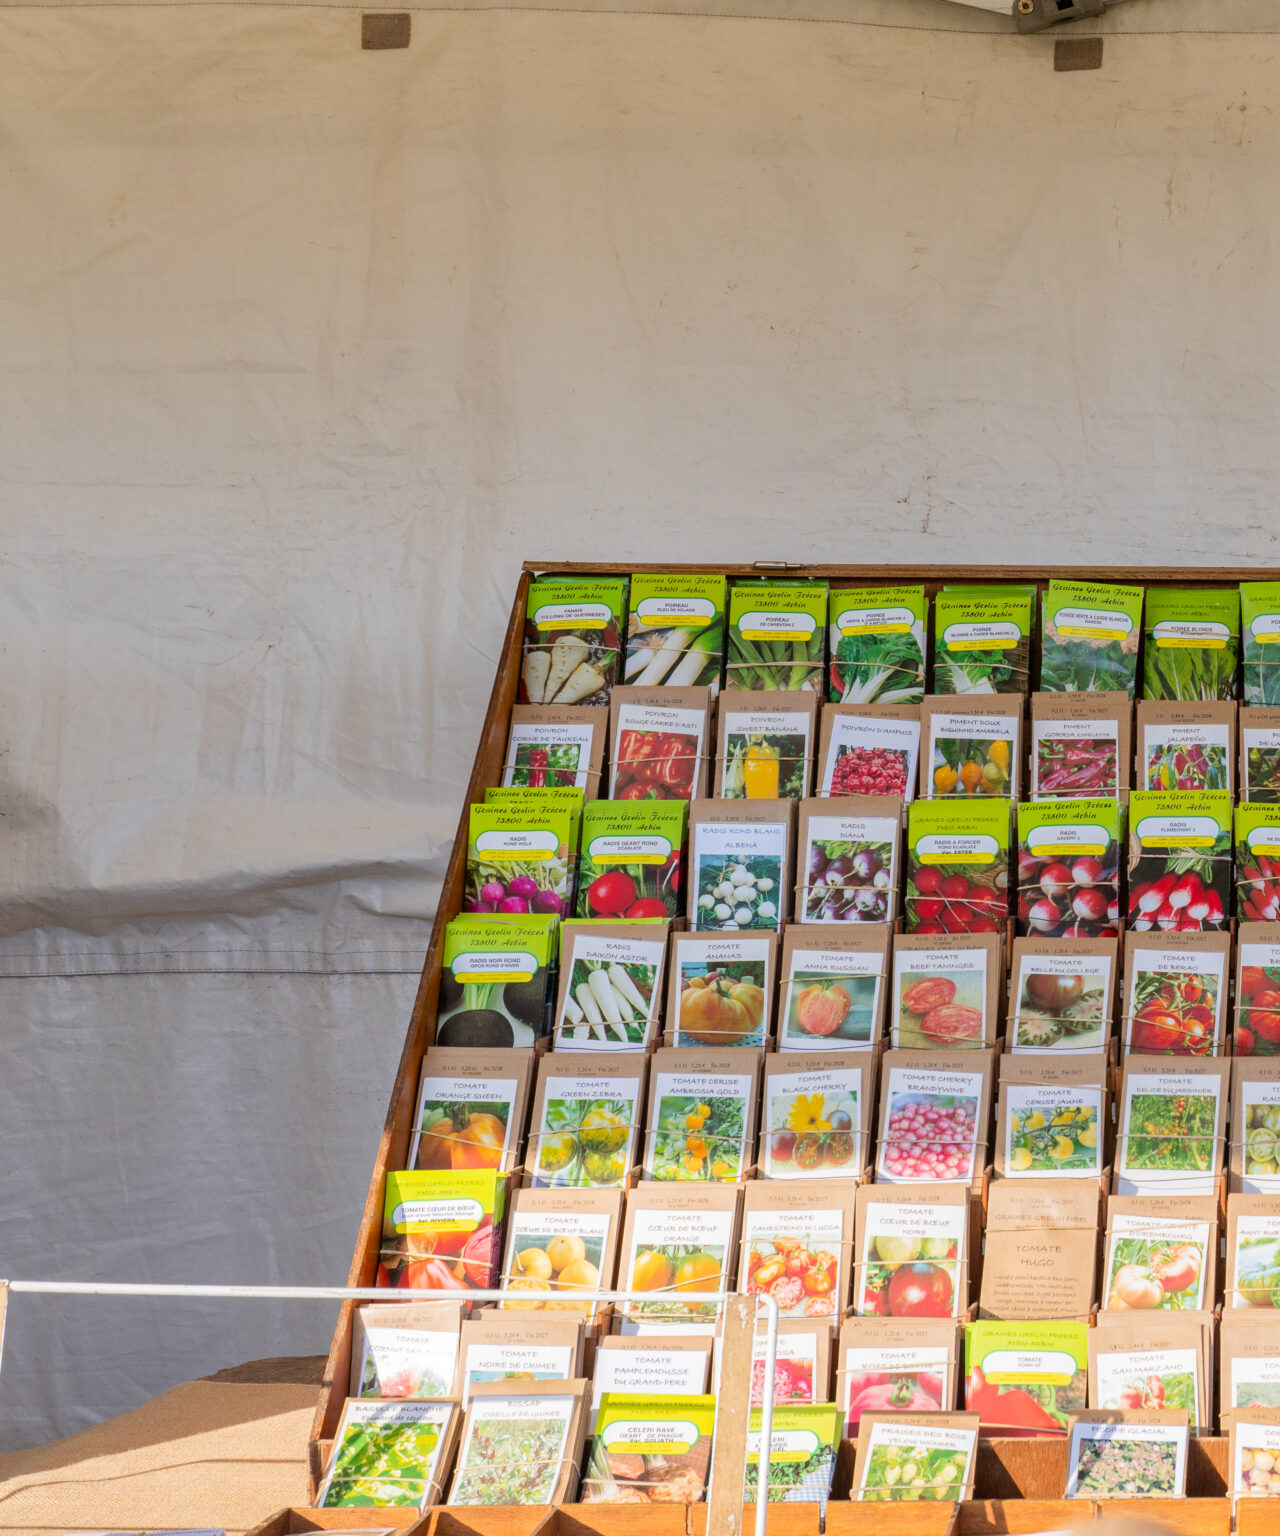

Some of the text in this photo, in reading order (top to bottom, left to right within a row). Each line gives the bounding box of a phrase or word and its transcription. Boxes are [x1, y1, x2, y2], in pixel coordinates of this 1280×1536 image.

[841, 725, 875, 733] POIVRON
[605, 943, 631, 951] RADIS
[1015, 1245, 1062, 1253] TOMATE
